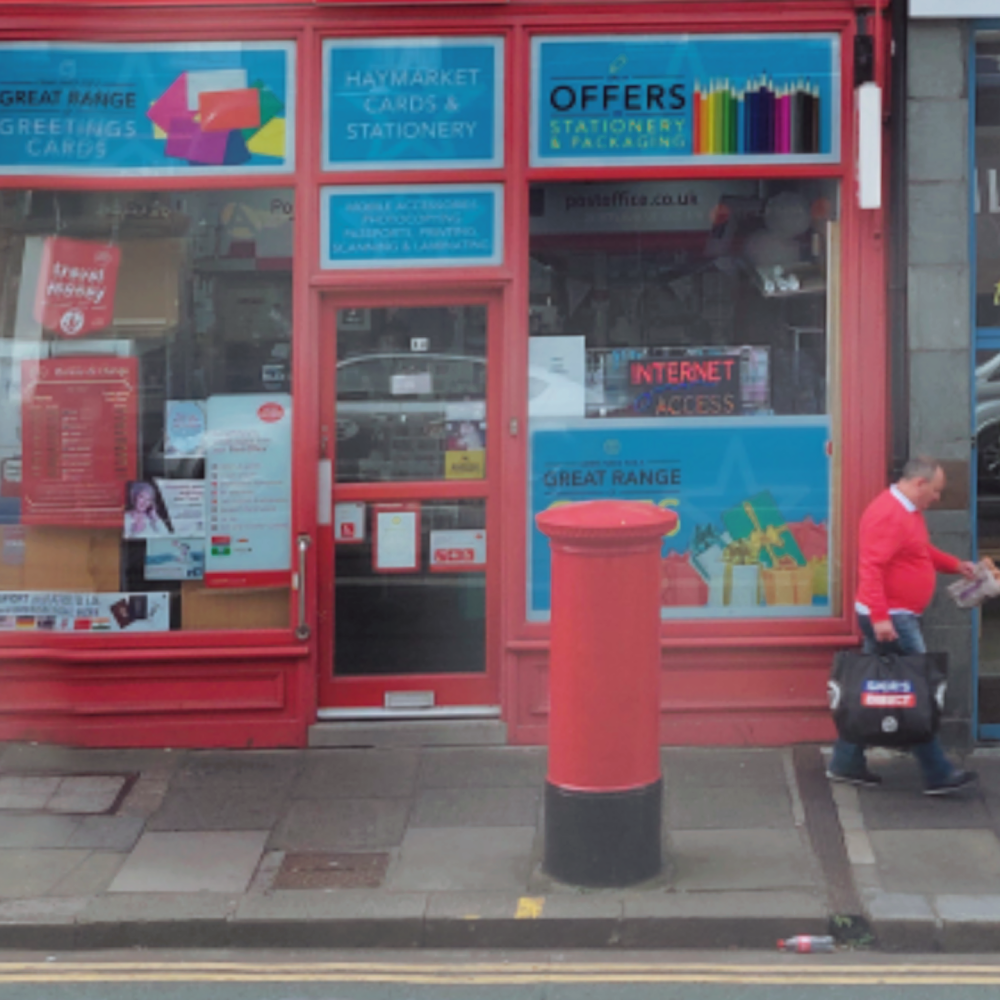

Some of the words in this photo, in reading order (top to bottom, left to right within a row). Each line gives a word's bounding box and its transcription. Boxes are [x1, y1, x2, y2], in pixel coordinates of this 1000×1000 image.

[345, 67, 480, 86] HAYMARKET
[68, 91, 136, 109] RANGE
[363, 95, 437, 113] CARDS
[550, 84, 686, 111] OFFERS
[346, 121, 478, 139] STATIONERY
[550, 119, 686, 134] STATIONERY
[26, 137, 106, 158] CARDS
[571, 135, 686, 149] PACKAGING
[630, 359, 735, 385] INTERNET
[655, 394, 735, 415] ACCESS
[543, 469, 607, 487] GREAT
[612, 468, 682, 486] RANGE
